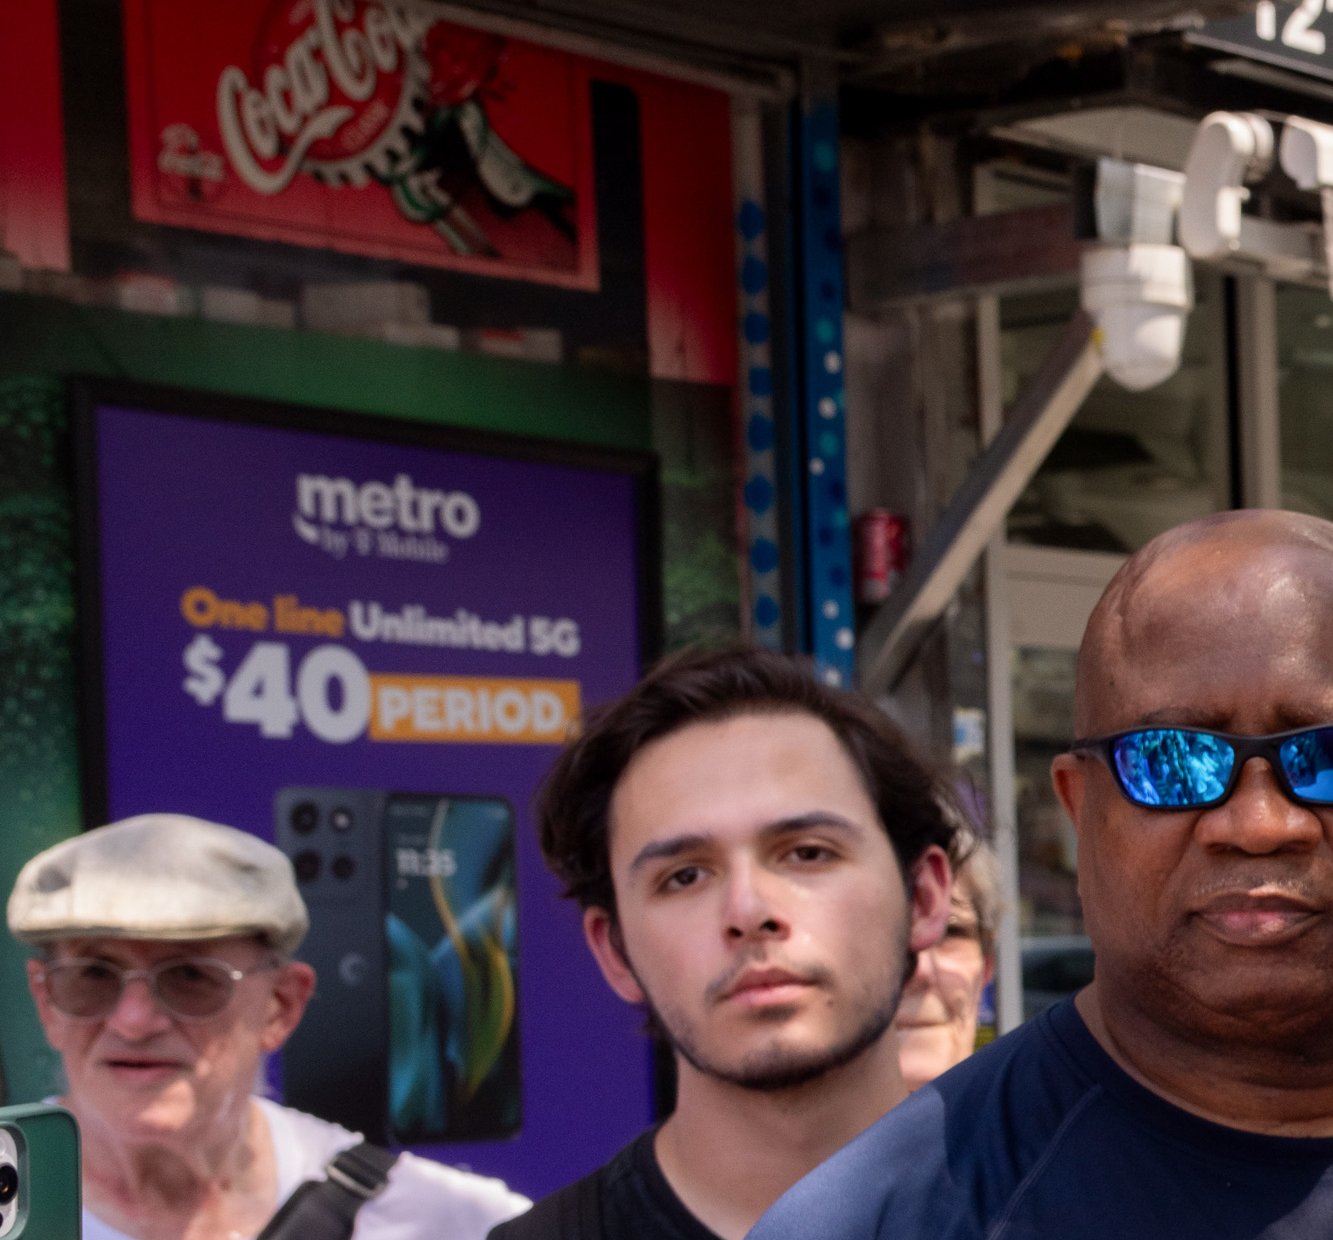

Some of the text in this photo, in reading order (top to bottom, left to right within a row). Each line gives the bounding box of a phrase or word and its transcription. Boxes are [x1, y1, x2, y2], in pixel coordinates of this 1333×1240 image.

[297, 473, 481, 539] metro
[181, 587, 582, 657] One line Unlimited 5G
[183, 633, 373, 744] $40
